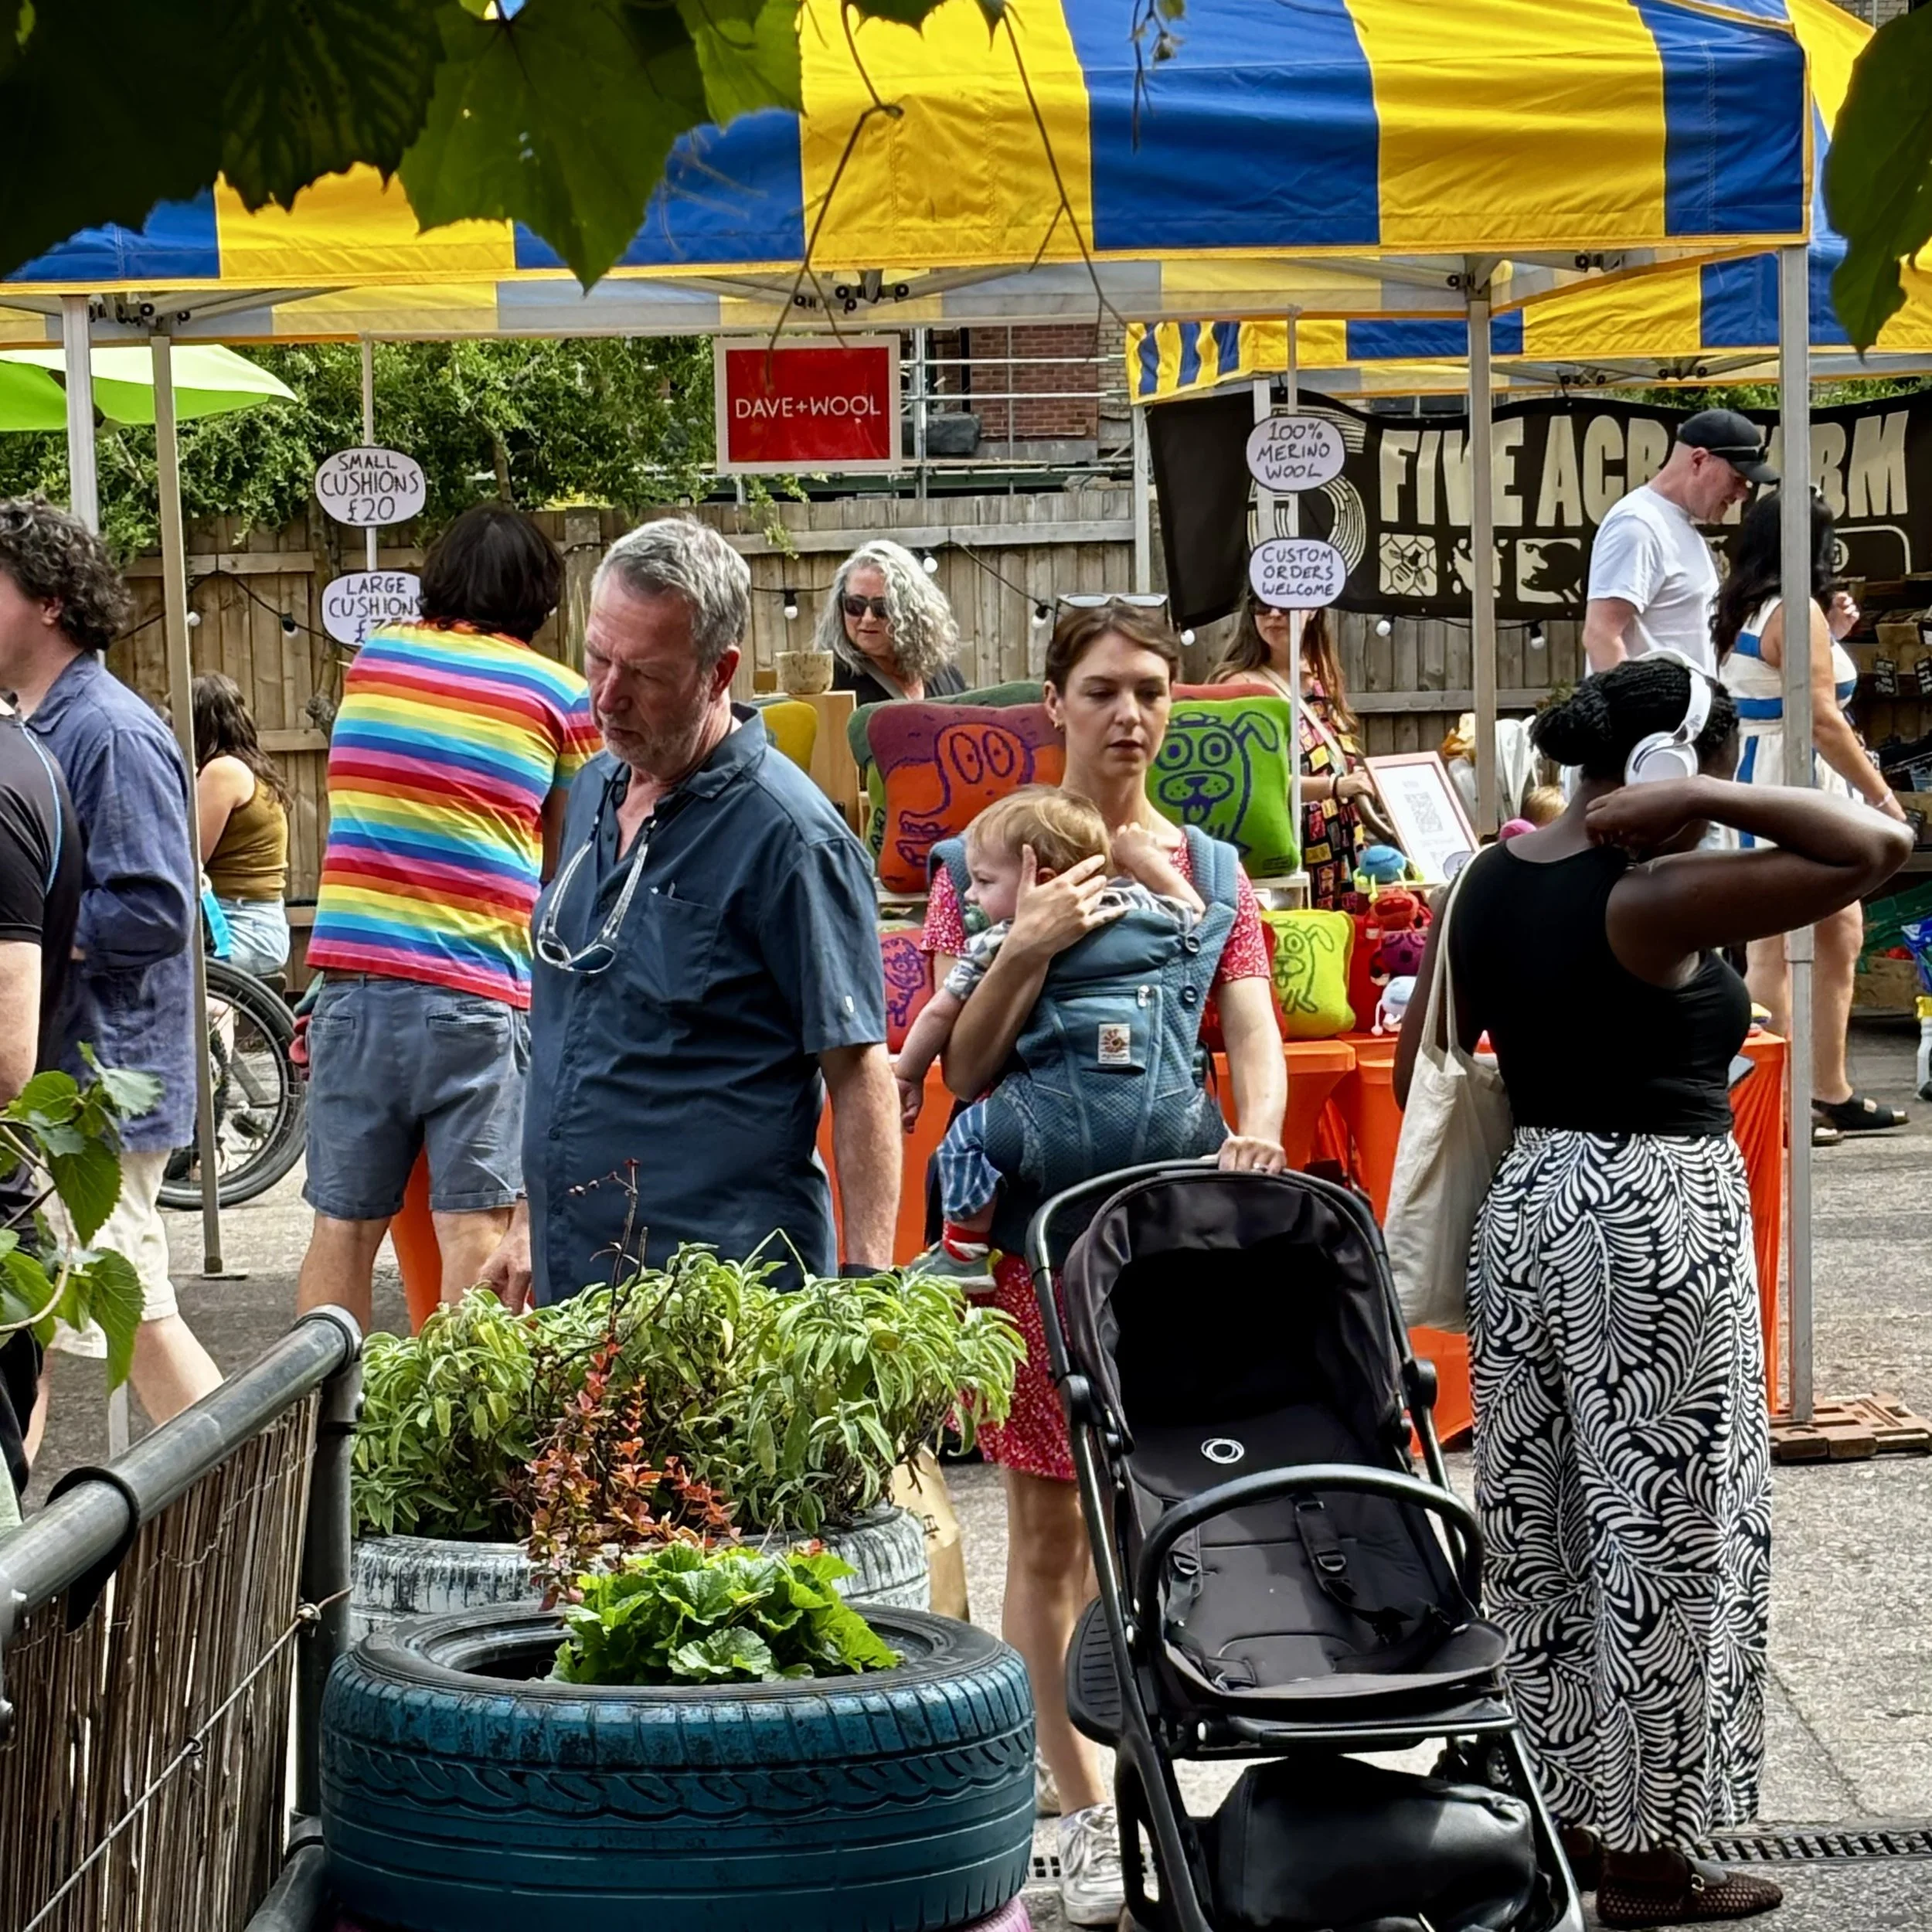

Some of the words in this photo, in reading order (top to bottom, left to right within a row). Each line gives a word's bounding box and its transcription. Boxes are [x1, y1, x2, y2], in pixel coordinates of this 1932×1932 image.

[736, 394, 881, 419] DAVE+WOOL
[1267, 421, 1323, 441] 100%
[338, 454, 397, 471] SMALL
[1257, 443, 1330, 463] MERINO
[1265, 464, 1322, 480] WOOL
[1536, 415, 1686, 527] ACR
[320, 471, 419, 497] CUSHIONS
[346, 497, 396, 523] £20
[1261, 547, 1334, 564] CUSTOM
[1263, 565, 1334, 580] ORDERS
[346, 576, 406, 595] LARGE
[1262, 582, 1335, 596] WELCOME
